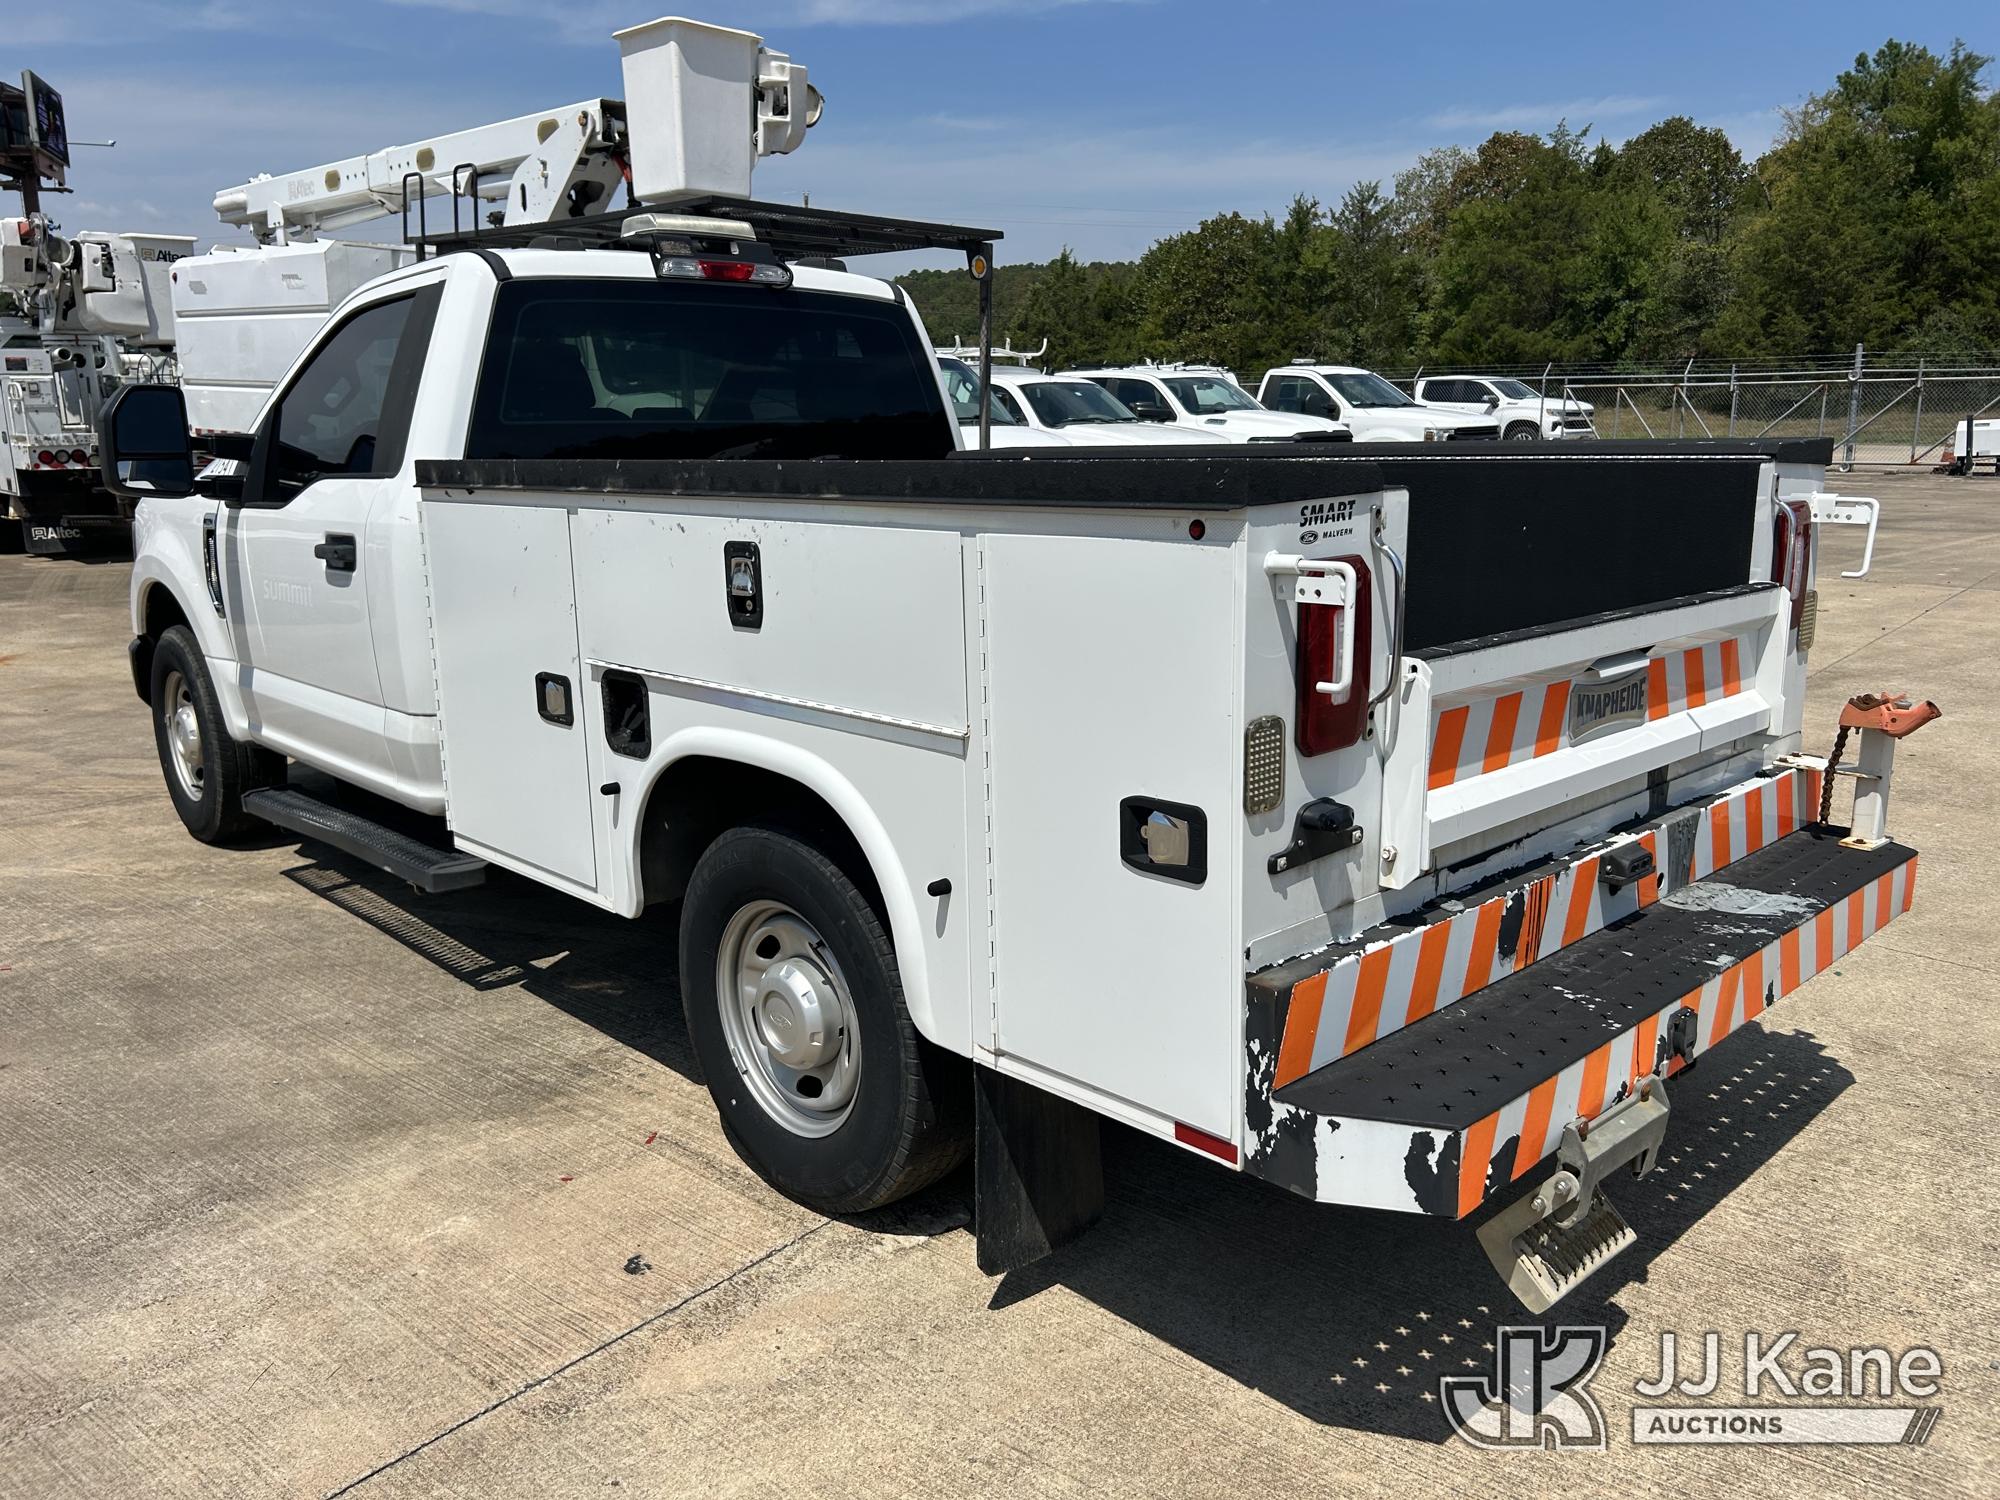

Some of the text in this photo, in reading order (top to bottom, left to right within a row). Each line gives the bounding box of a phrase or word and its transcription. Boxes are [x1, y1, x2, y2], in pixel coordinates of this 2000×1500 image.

[1300, 500, 1356, 527] SMART
[47, 526, 81, 540] Altec
[1322, 528, 1353, 539] MALVERN
[1577, 676, 1646, 720] KNAPHEIDE
